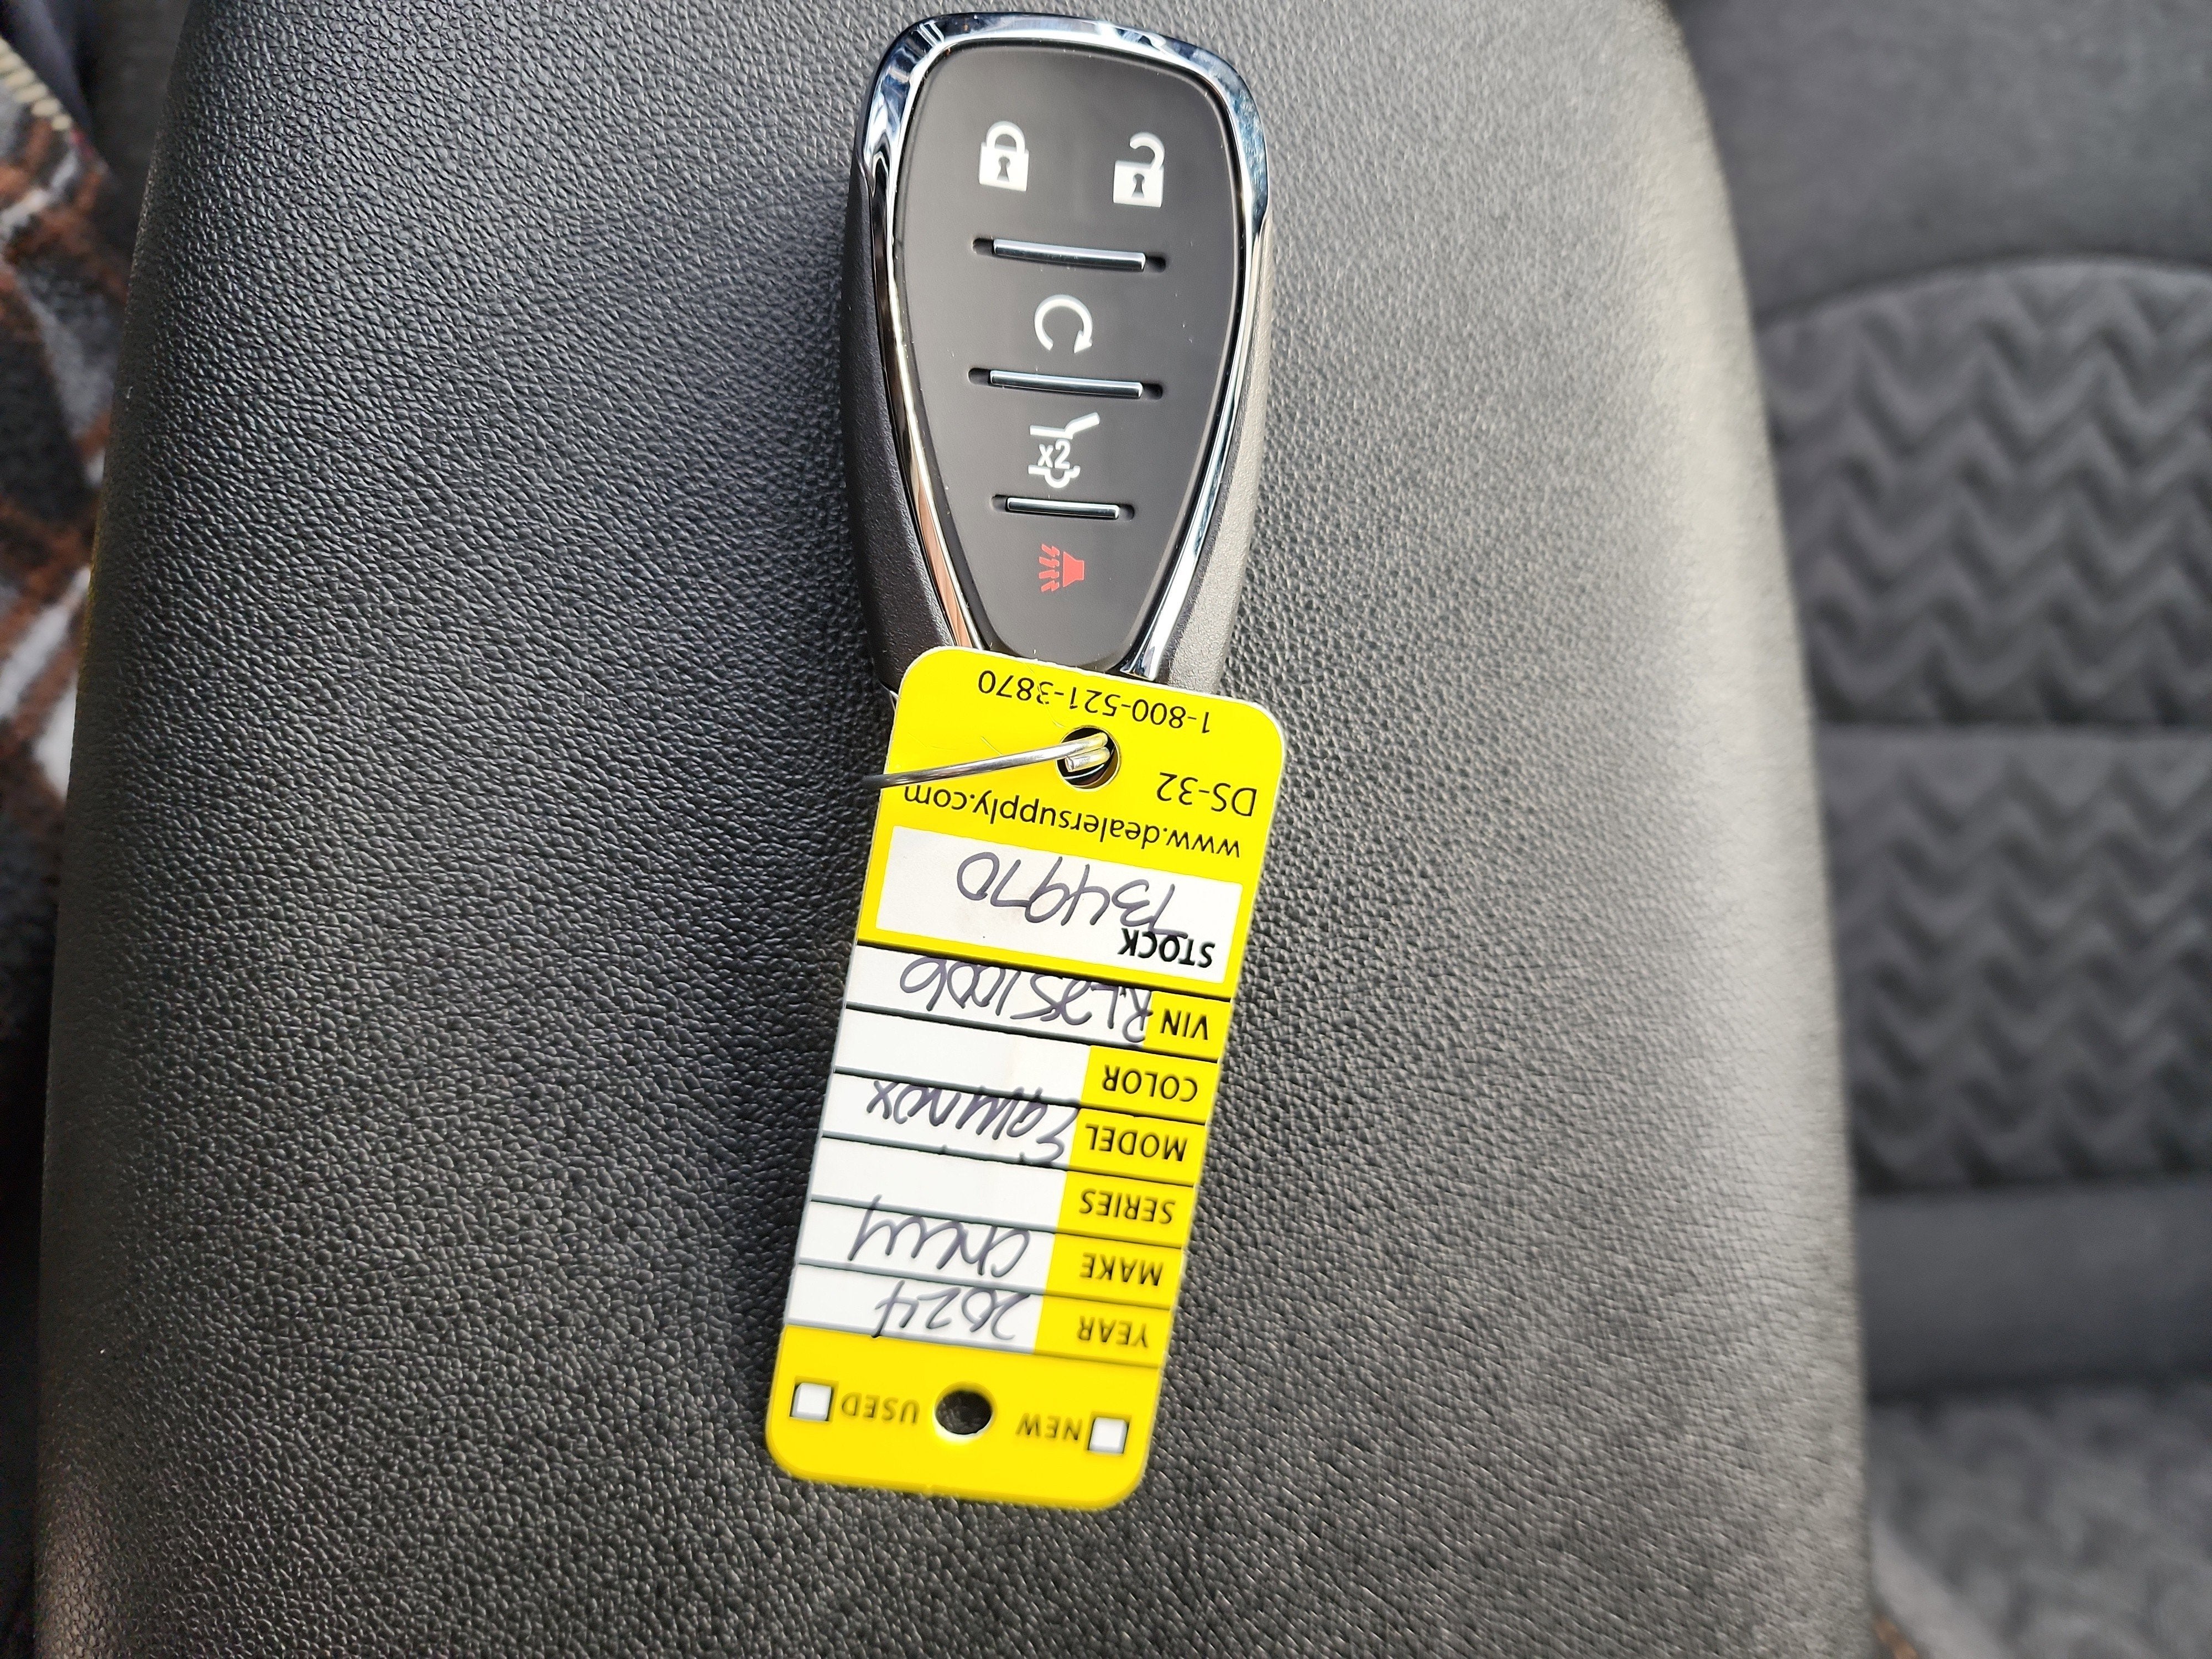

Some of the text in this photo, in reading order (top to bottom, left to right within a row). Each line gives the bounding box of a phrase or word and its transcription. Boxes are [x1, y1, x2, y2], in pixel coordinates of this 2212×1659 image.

[977, 669, 1211, 734] 1-800-521-3870
[1156, 771, 1258, 817] DS-32
[903, 786, 1240, 859] www.dealersupply.com
[957, 852, 1188, 938] 734970
[1117, 927, 1215, 968] STOCK
[1159, 1008, 1209, 1041] VIN
[1101, 1064, 1198, 1103] COLOR
[1084, 1124, 1187, 1162] MODEL
[1078, 1189, 1176, 1225] SERIES
[1079, 1252, 1163, 1287] MAKE
[870, 1279, 1030, 1341] 2024
[1076, 1316, 1149, 1349] YEAR
[840, 1391, 920, 1426] USED
[1016, 1412, 1083, 1442] NEW
